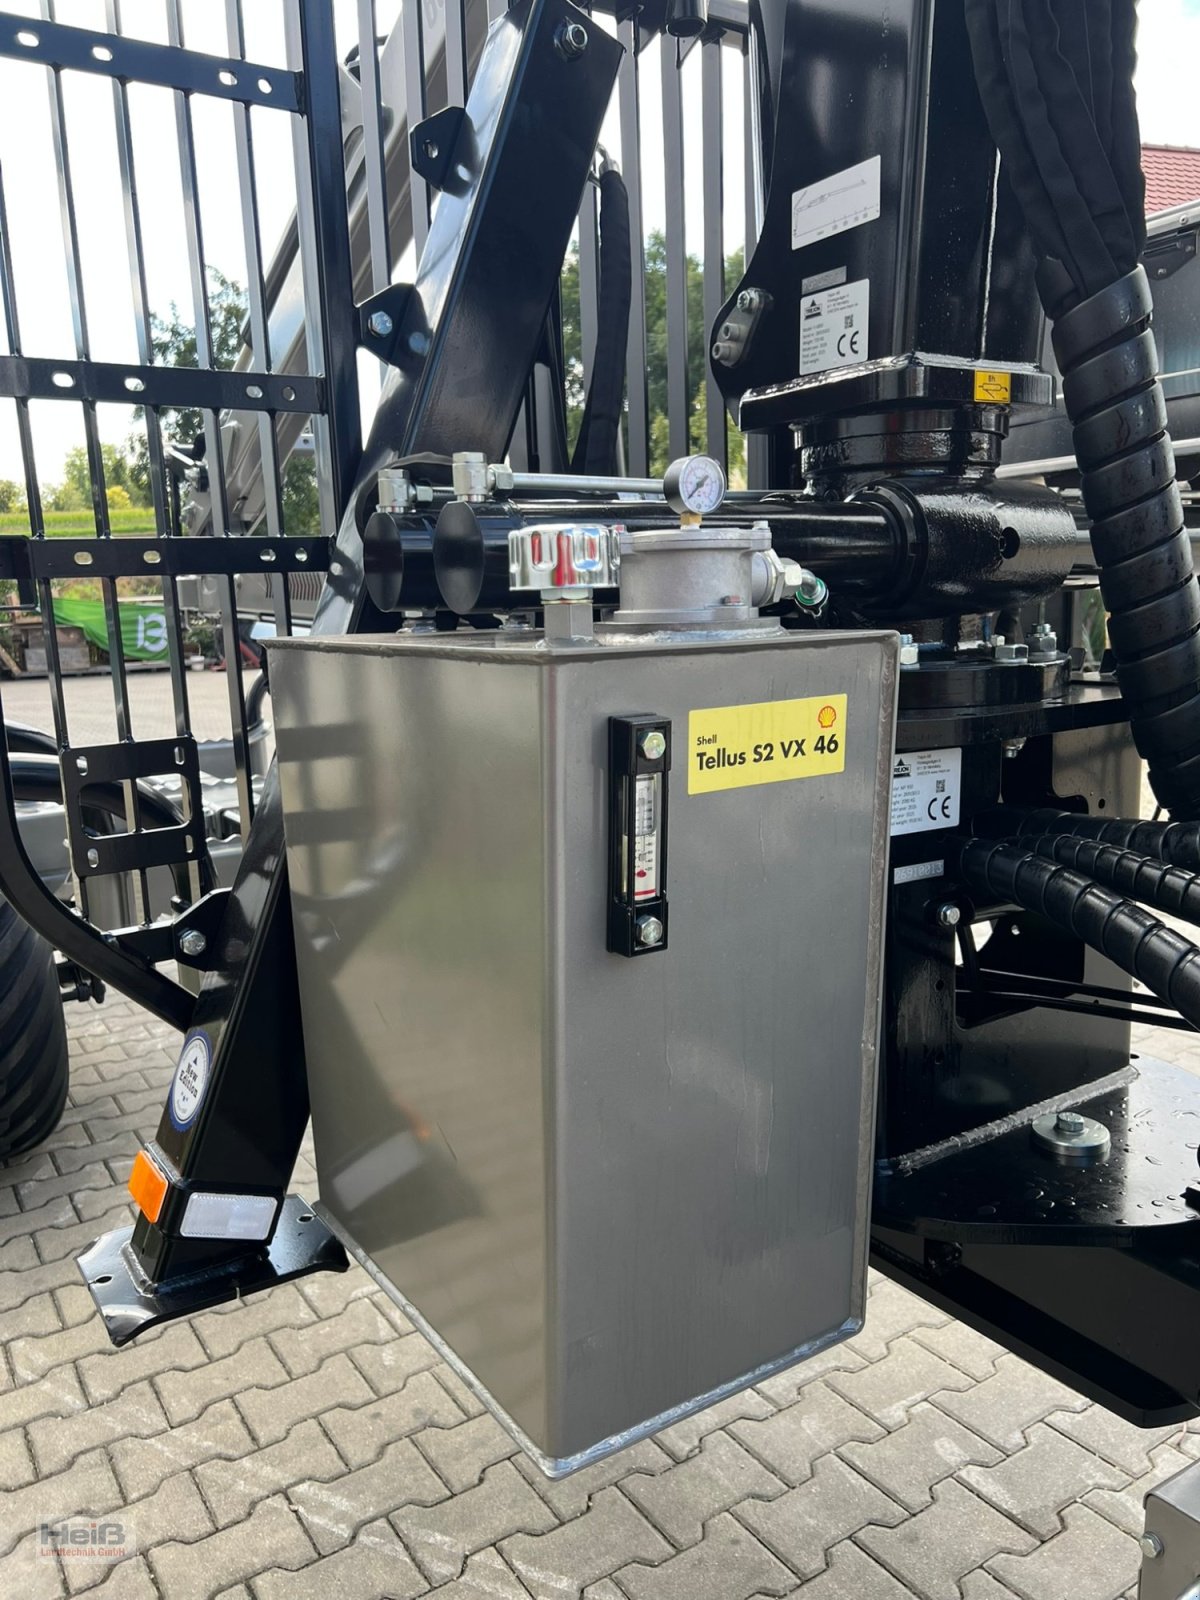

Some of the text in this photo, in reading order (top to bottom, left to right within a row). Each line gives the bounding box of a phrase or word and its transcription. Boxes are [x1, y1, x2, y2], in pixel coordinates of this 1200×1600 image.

[696, 734, 718, 746] Shell
[696, 733, 840, 771] Tellus S2 VX 46
[179, 1069, 199, 1099] Edition
[185, 1062, 199, 1083] New
